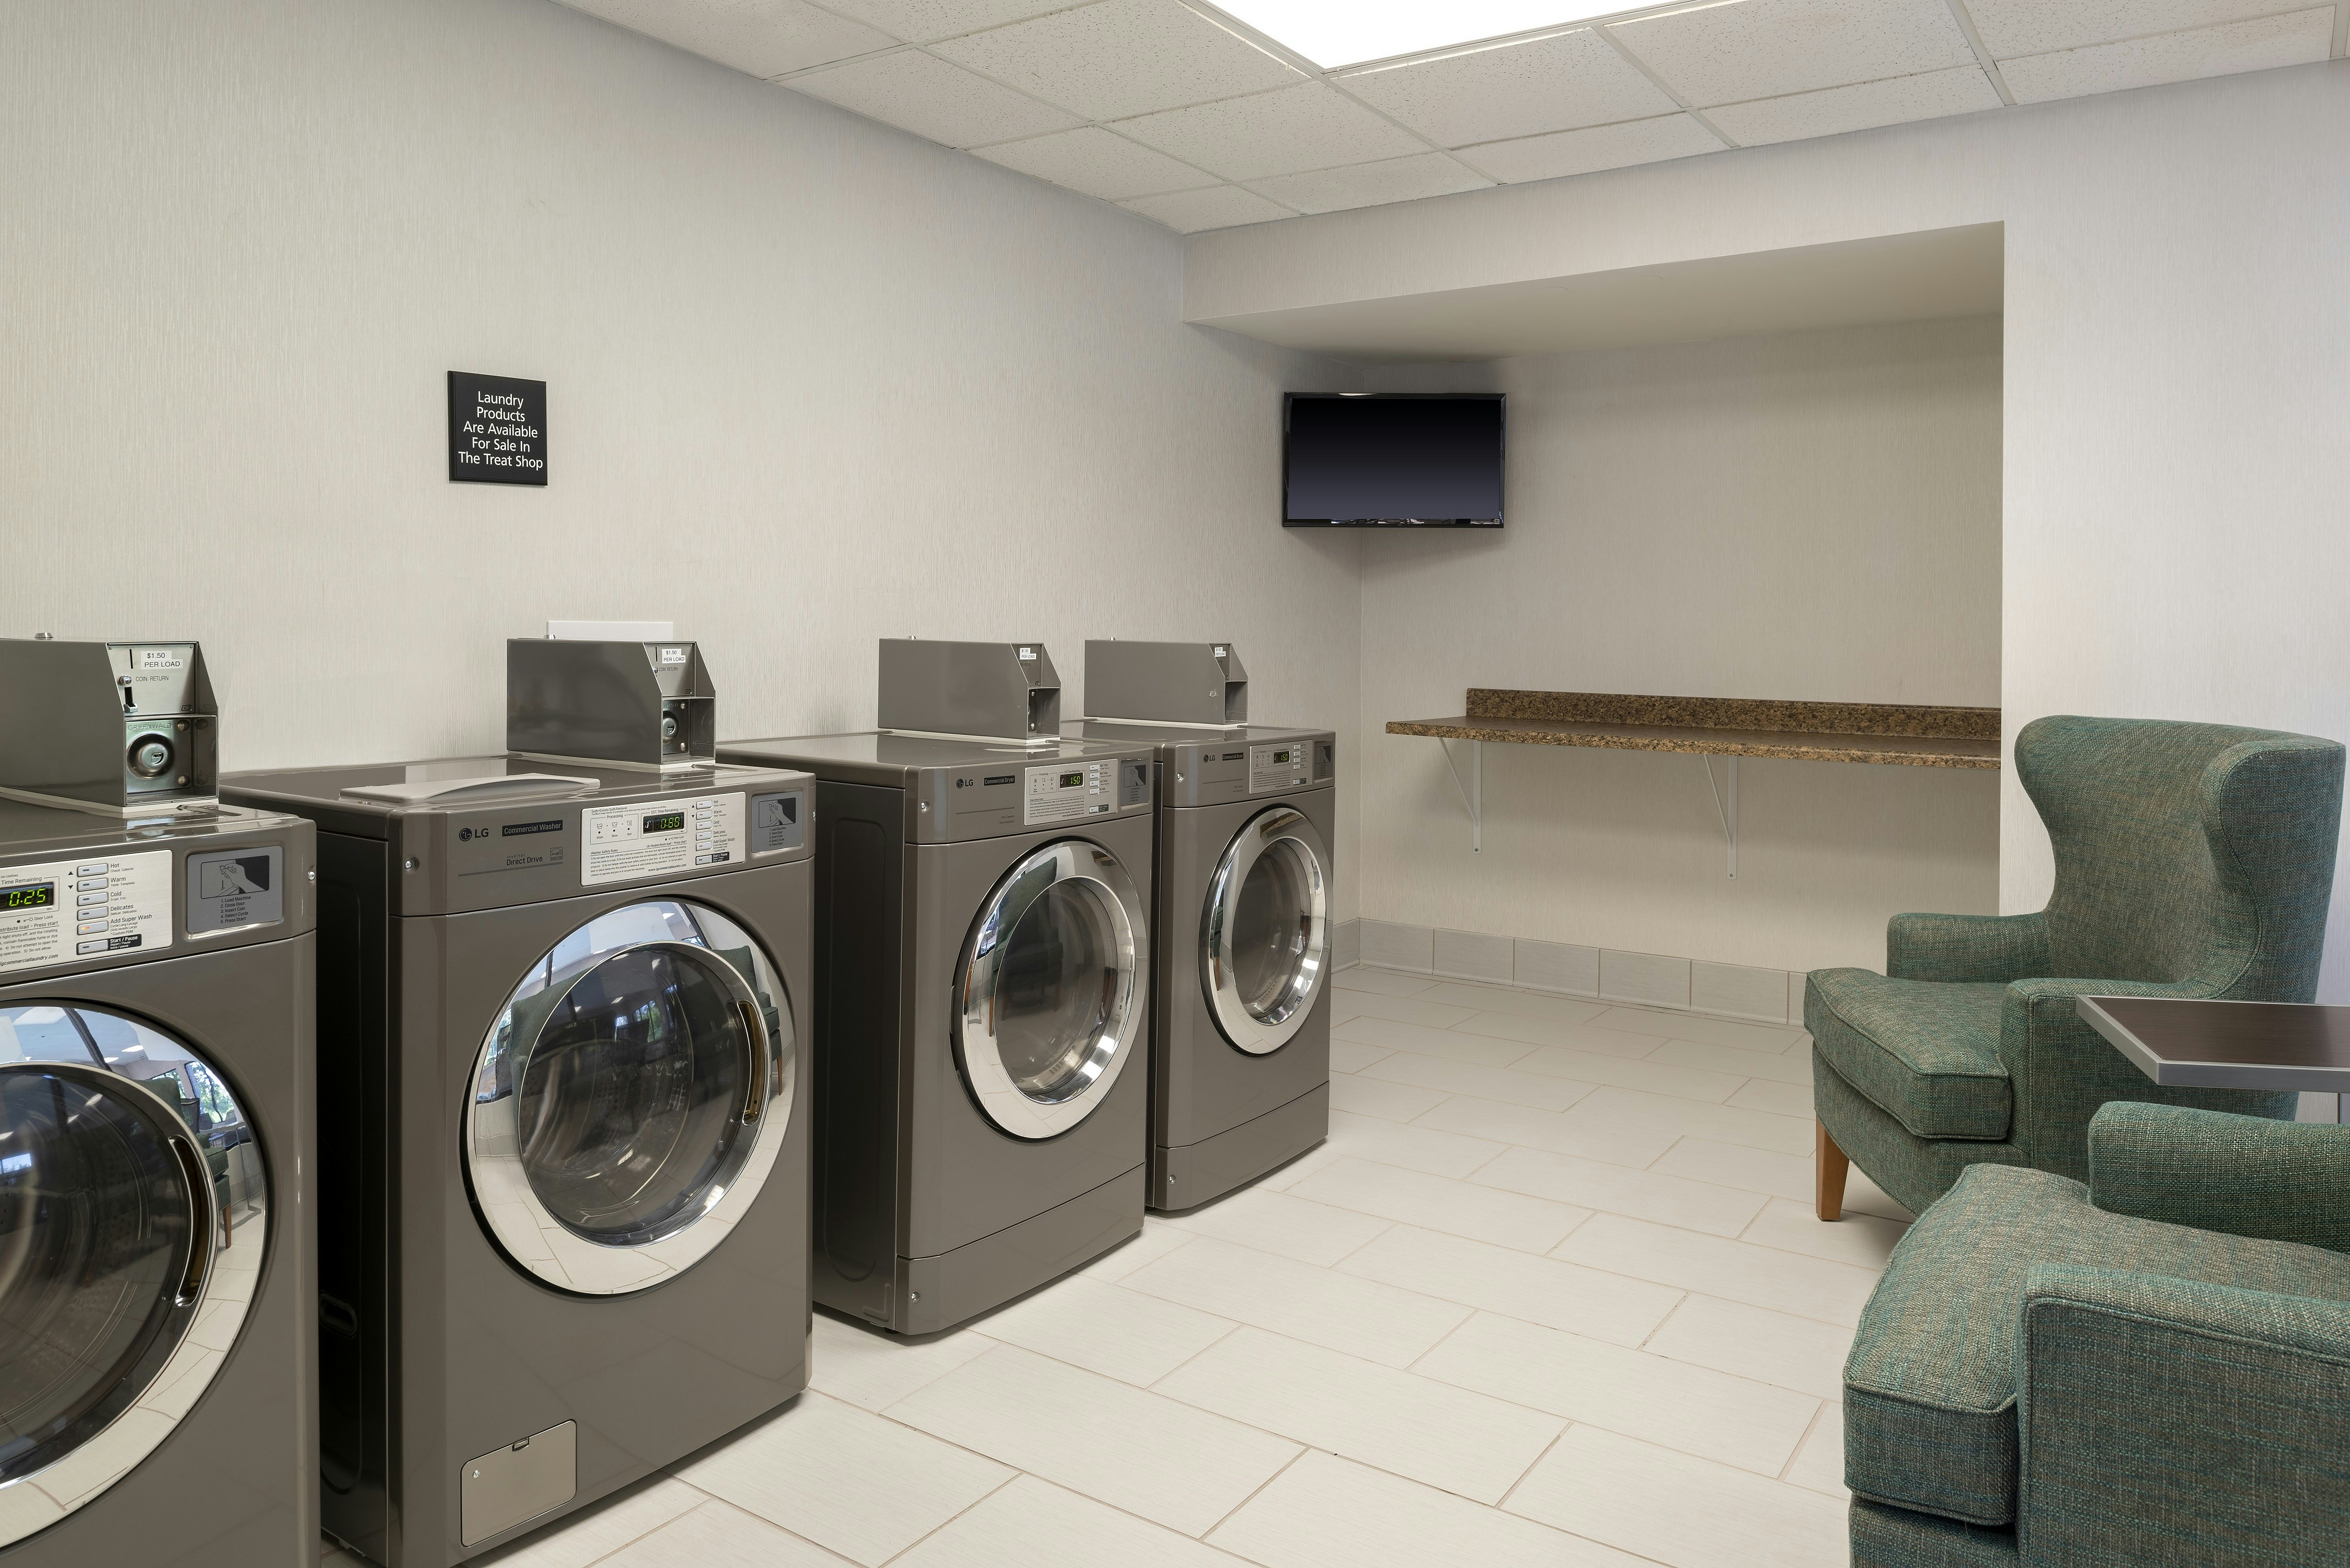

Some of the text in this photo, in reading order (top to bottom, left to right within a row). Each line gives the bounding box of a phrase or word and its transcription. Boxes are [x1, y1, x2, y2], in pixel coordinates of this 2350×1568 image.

[478, 391, 524, 409] Laundry
[477, 407, 525, 421] Products
[463, 421, 537, 437] Are Available
[473, 437, 530, 452] For Sale In
[458, 452, 543, 470] The Treat Shop
[128, 722, 172, 731] GREENWALD
[475, 828, 489, 838] LG
[504, 825, 538, 834] Commercial
[507, 857, 525, 866] Direct
[9, 889, 45, 906] 0.25
